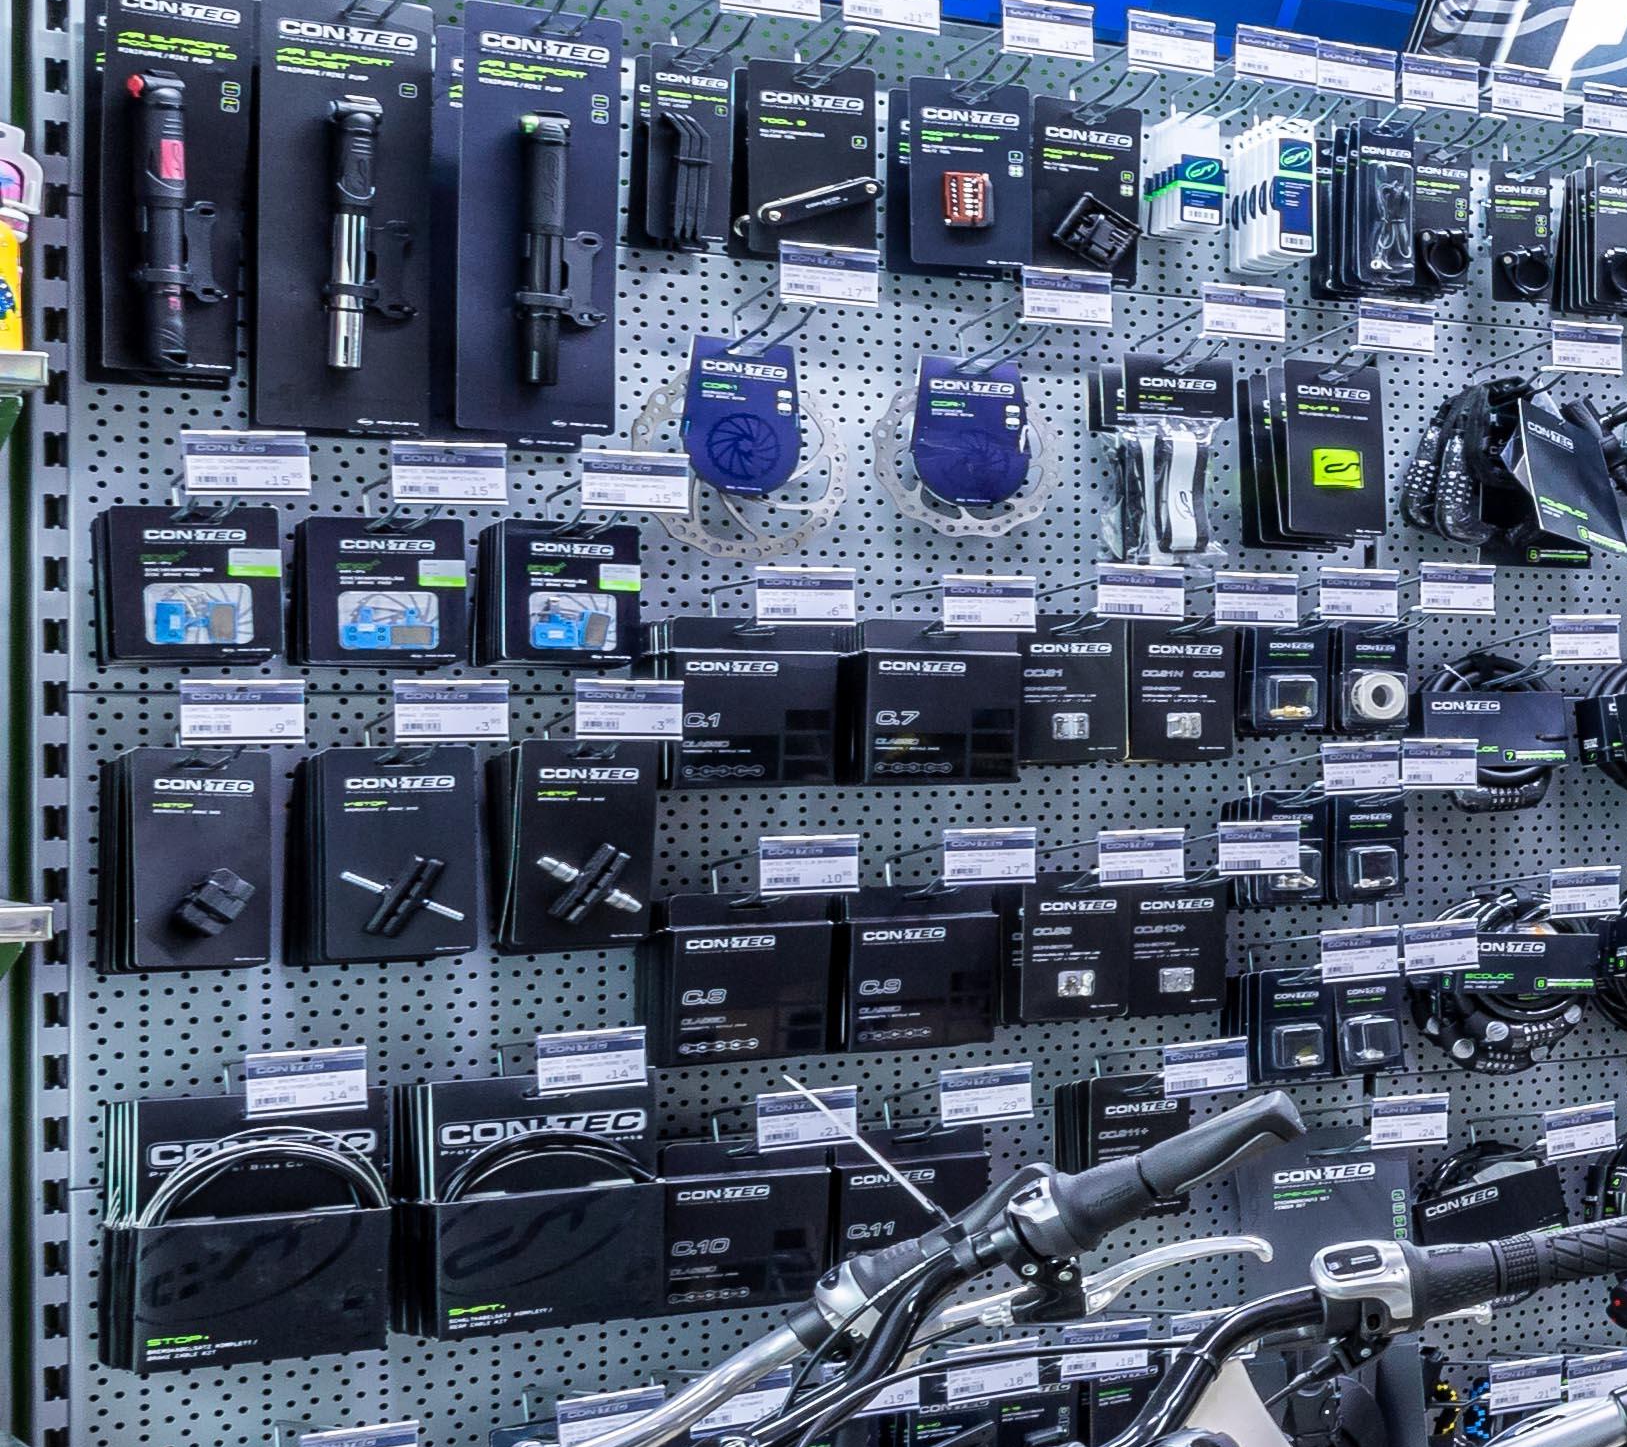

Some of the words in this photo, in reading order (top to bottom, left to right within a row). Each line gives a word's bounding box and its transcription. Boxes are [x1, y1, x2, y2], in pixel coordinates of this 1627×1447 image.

[151, 34, 230, 50] SUPPORT
[309, 50, 394, 68] SUPPORT
[510, 62, 588, 79] SUPPORT
